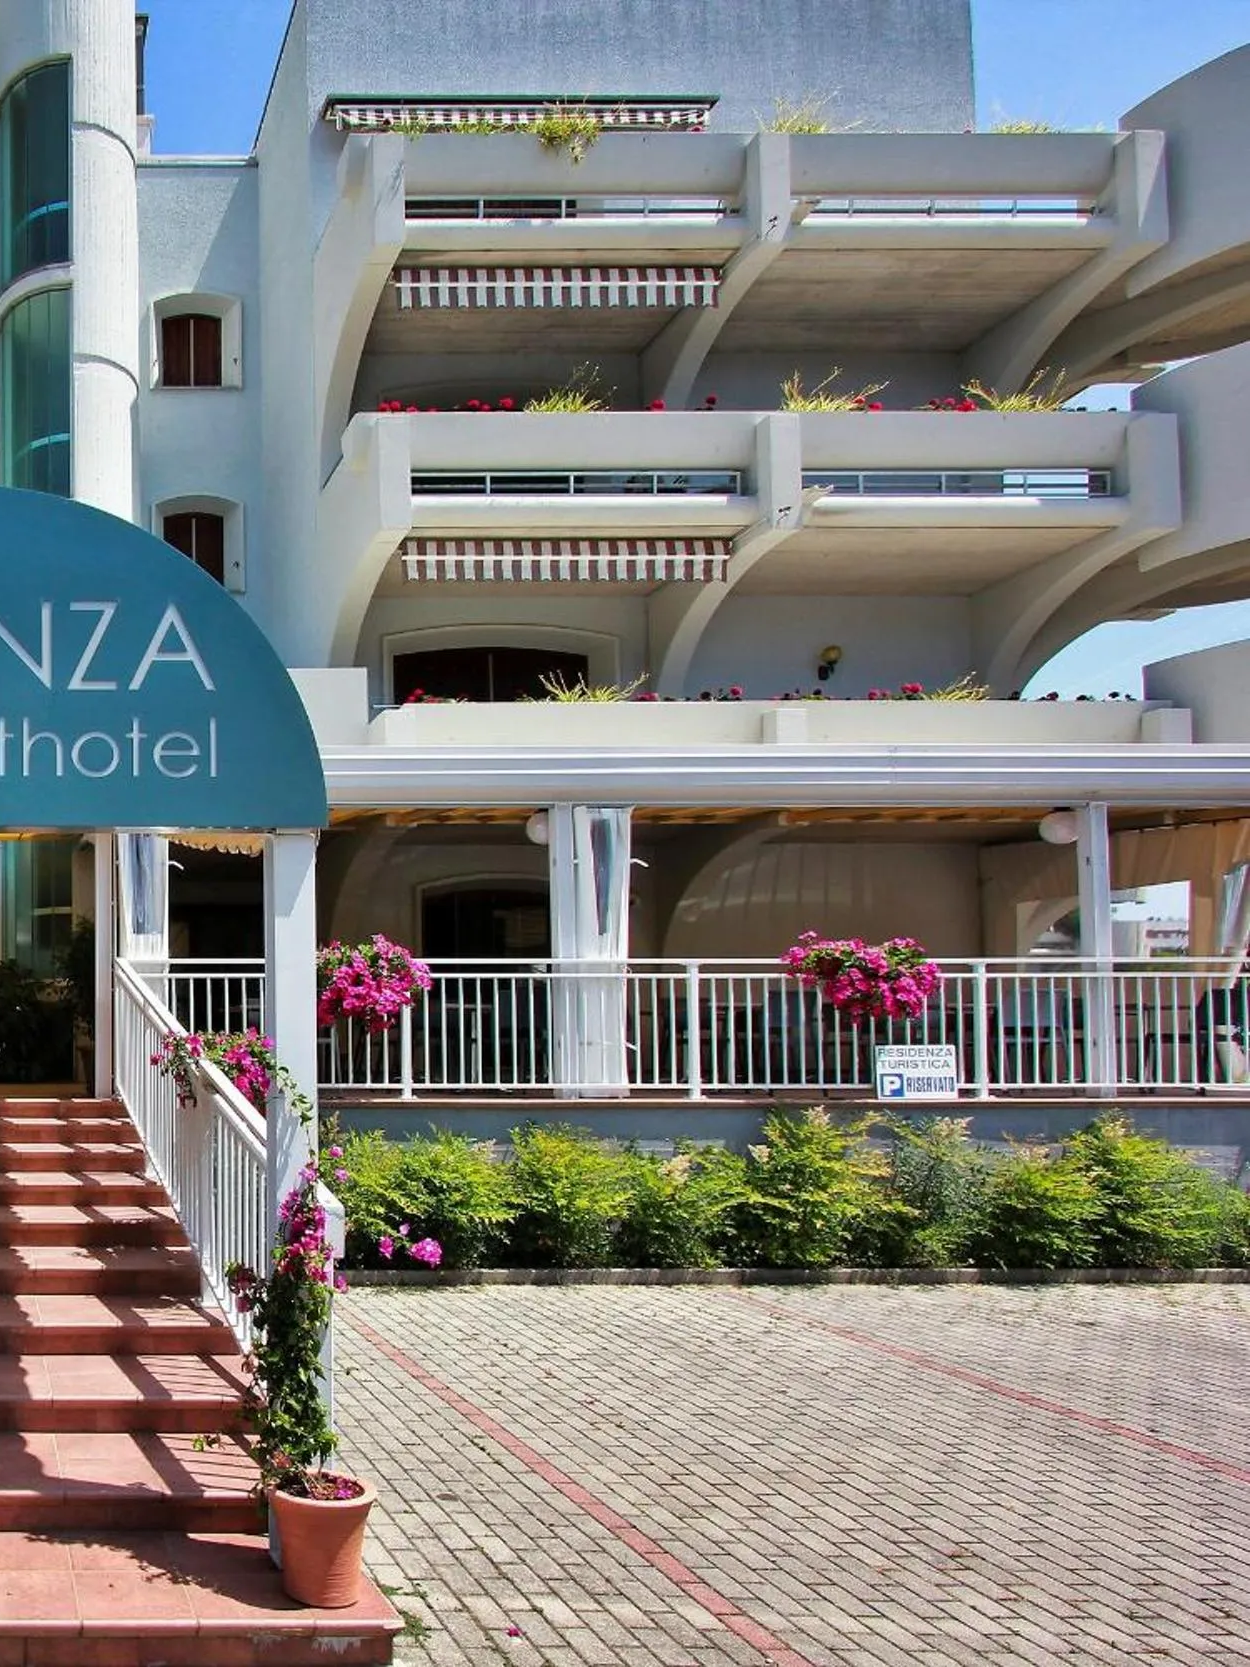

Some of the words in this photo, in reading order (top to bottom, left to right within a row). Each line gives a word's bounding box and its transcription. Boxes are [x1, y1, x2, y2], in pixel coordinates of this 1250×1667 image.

[877, 1047, 953, 1058] RESIDENZA
[880, 1060, 951, 1070] TURISTICA
[882, 1075, 902, 1096] P
[906, 1076, 955, 1092] RISERVATO
